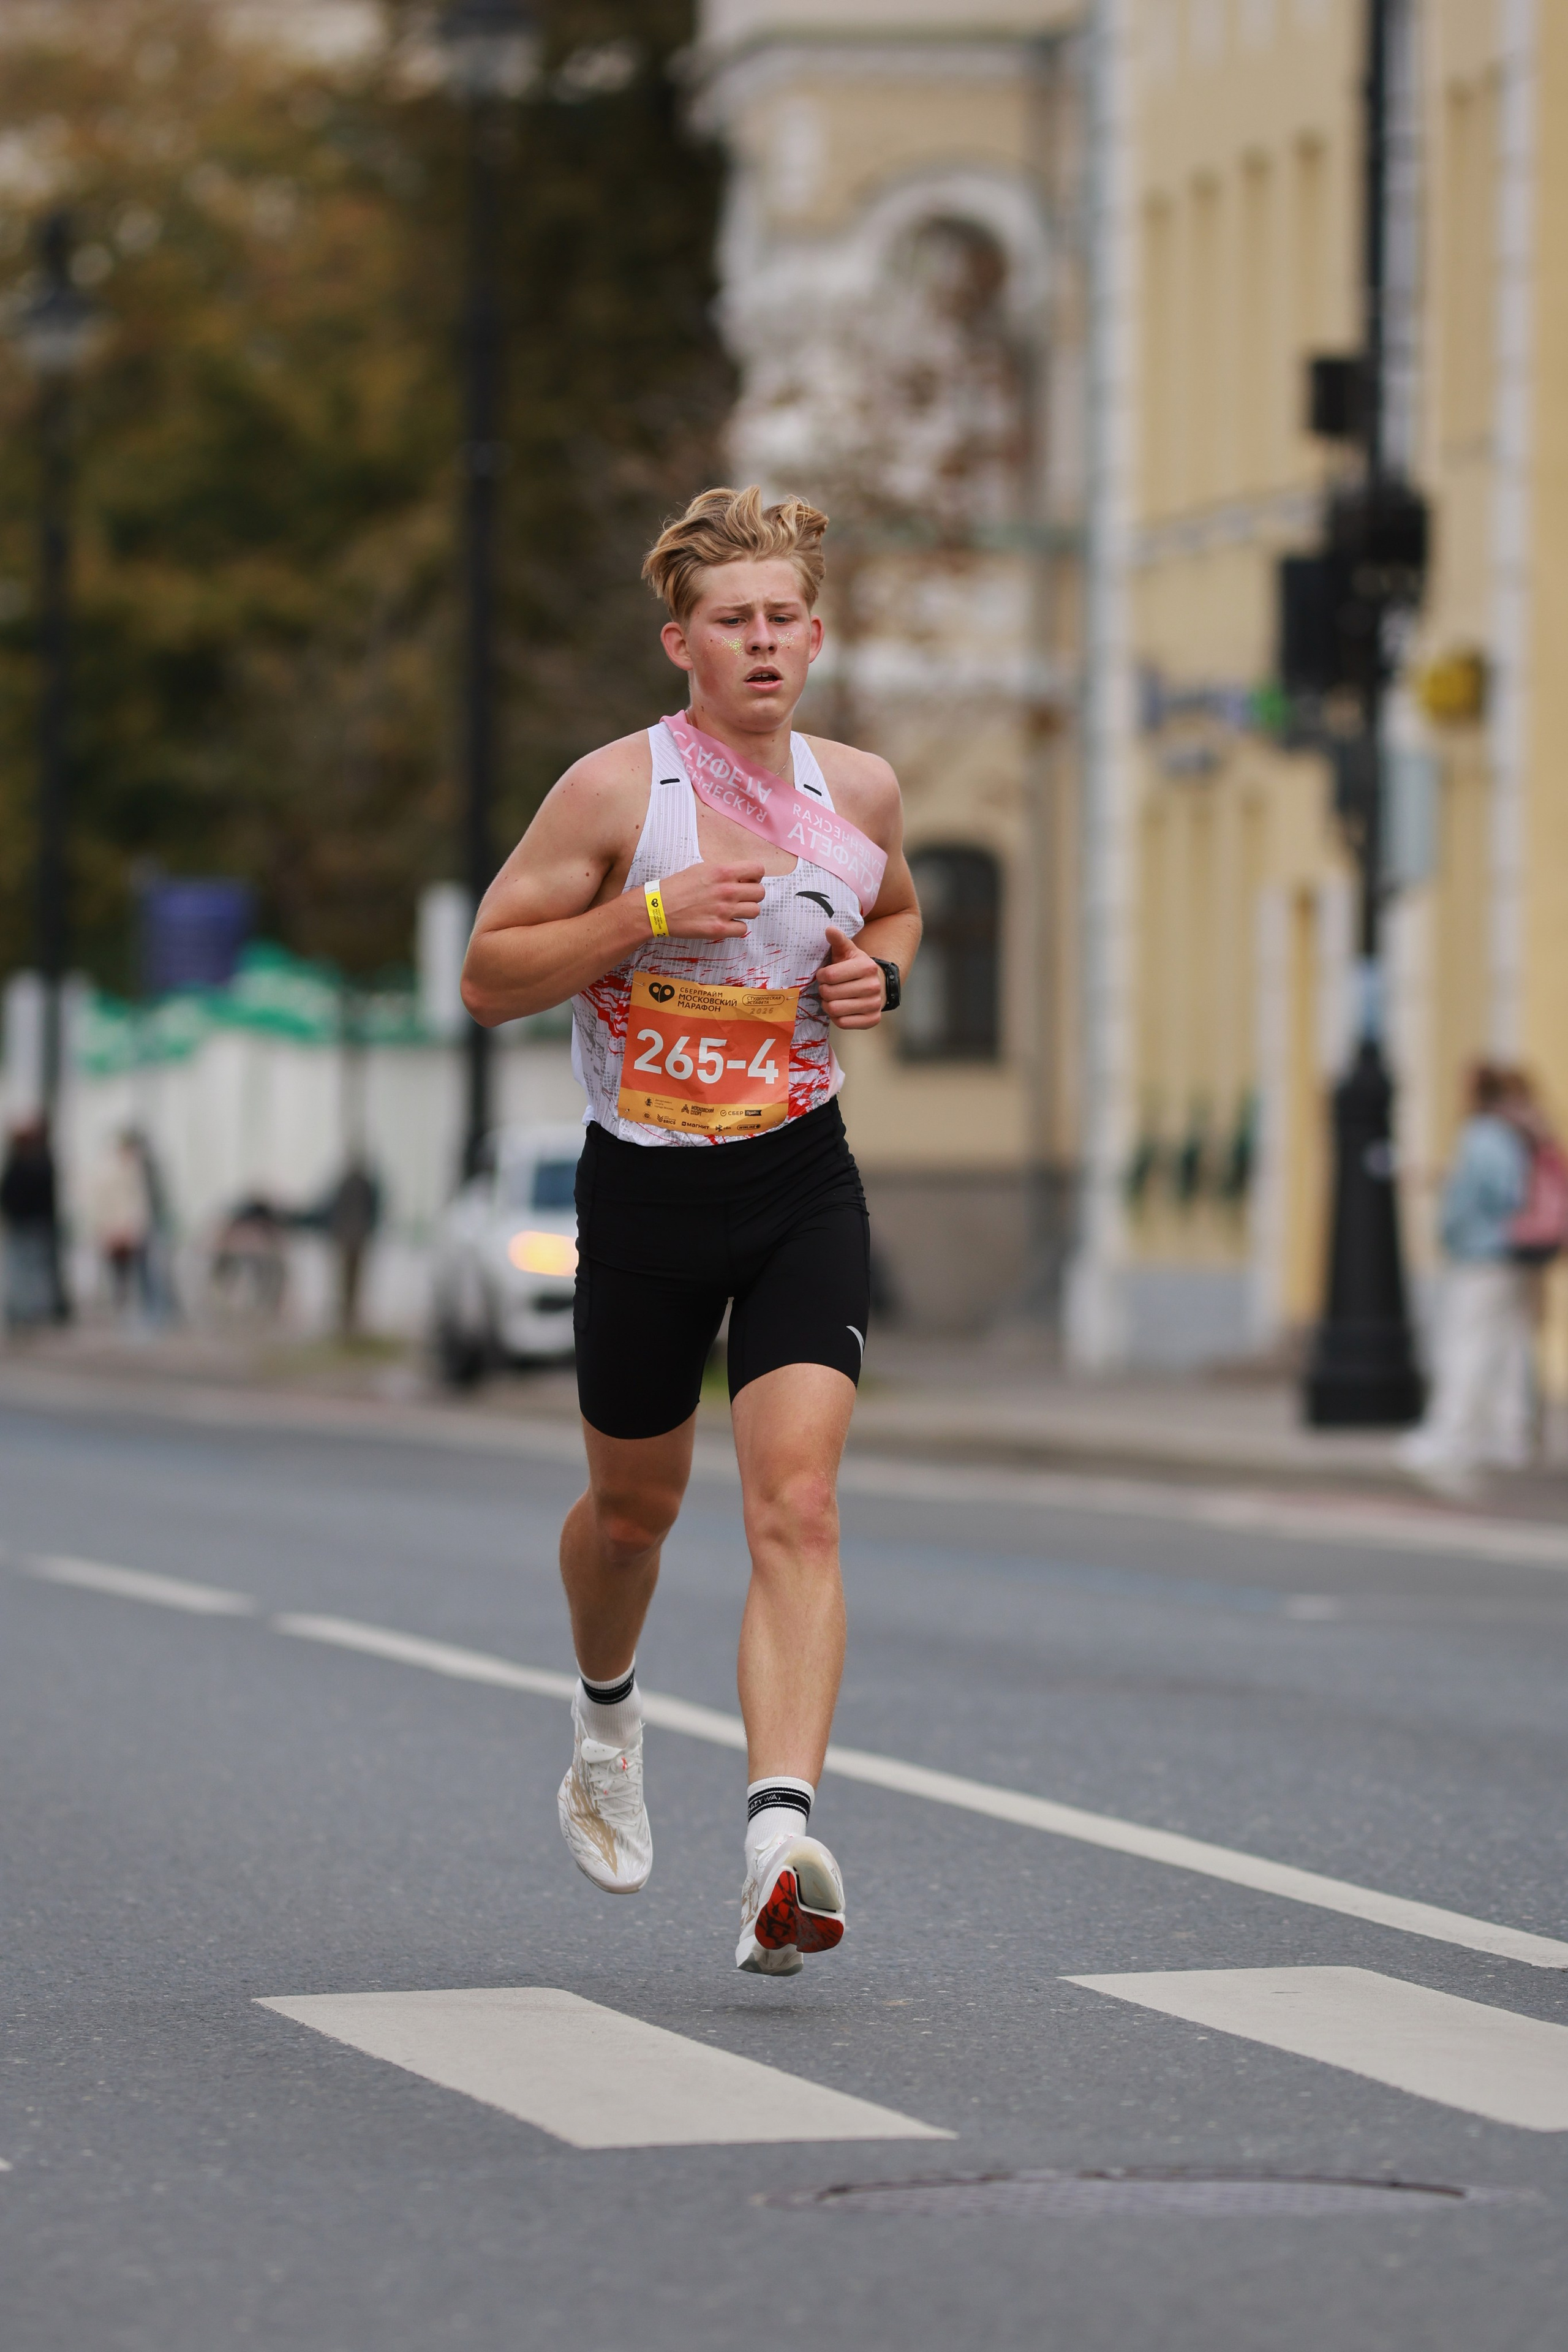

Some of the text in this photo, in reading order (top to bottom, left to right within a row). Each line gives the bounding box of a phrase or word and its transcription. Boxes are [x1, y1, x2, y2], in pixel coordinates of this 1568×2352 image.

[680, 987, 723, 998] СБЕРПРАЙМ
[678, 993, 737, 1007] МОСКОВСКИЙ
[677, 1001, 721, 1012] МАРАФОН
[633, 1028, 779, 1084] 265-4
[691, 1105, 714, 1114] МОСКОВСКИЙ
